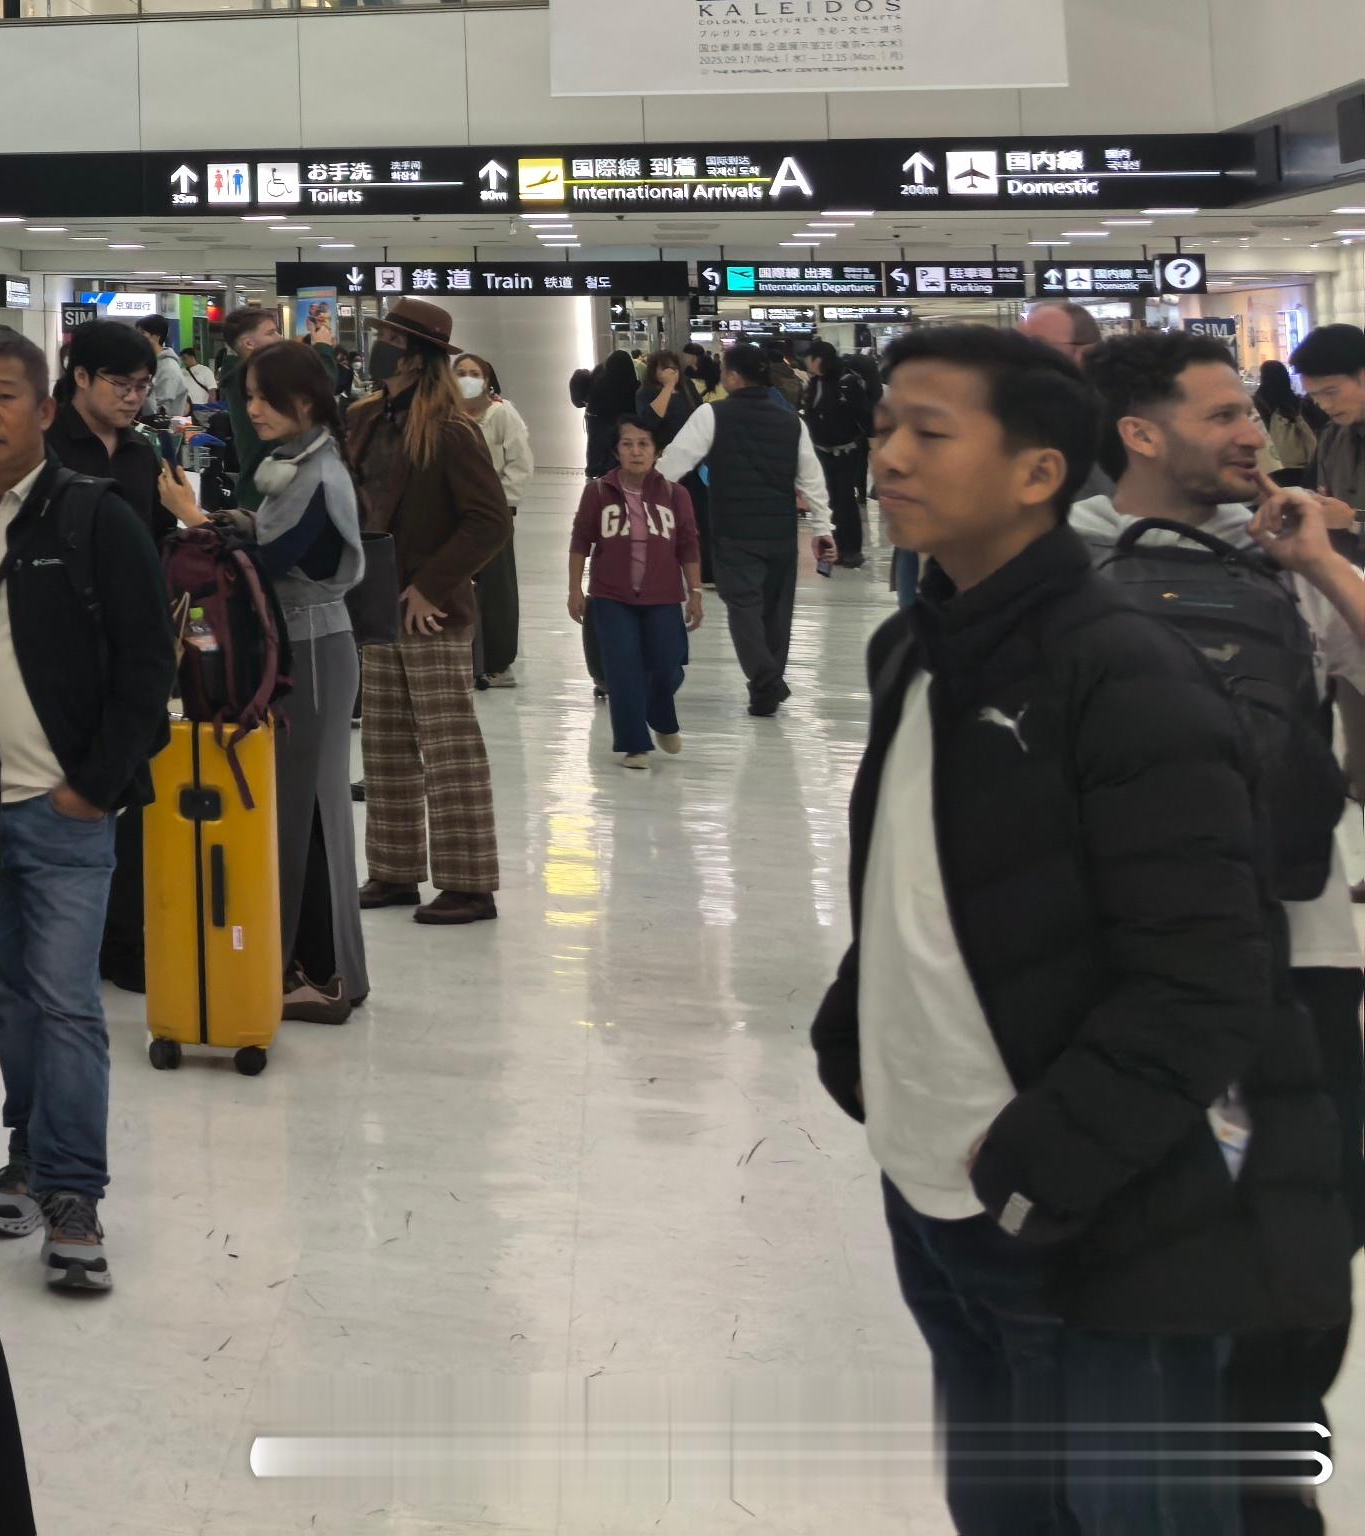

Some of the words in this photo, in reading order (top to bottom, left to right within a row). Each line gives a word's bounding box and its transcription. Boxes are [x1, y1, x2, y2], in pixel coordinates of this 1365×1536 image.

[699, 0, 901, 17] KALEIDOS
[572, 158, 640, 178] 国際線
[649, 157, 697, 177] 到着
[1005, 150, 1084, 171] 国内線
[307, 162, 373, 182] お手洗
[572, 184, 689, 200] International
[693, 183, 762, 199] Arrivals
[769, 156, 813, 196] A
[900, 184, 939, 196] 200m
[1007, 178, 1100, 195] Domestic
[172, 193, 199, 205] 35m
[308, 188, 363, 203] Toilets
[480, 190, 509, 202] 80m
[412, 268, 472, 291] 鉄道
[484, 271, 534, 291] Train
[1094, 282, 1139, 291] Domestic
[758, 283, 820, 292] International
[822, 283, 876, 293] Departures
[950, 284, 993, 295] Parking
[64, 310, 94, 326] SIM
[1191, 322, 1229, 337] SIM
